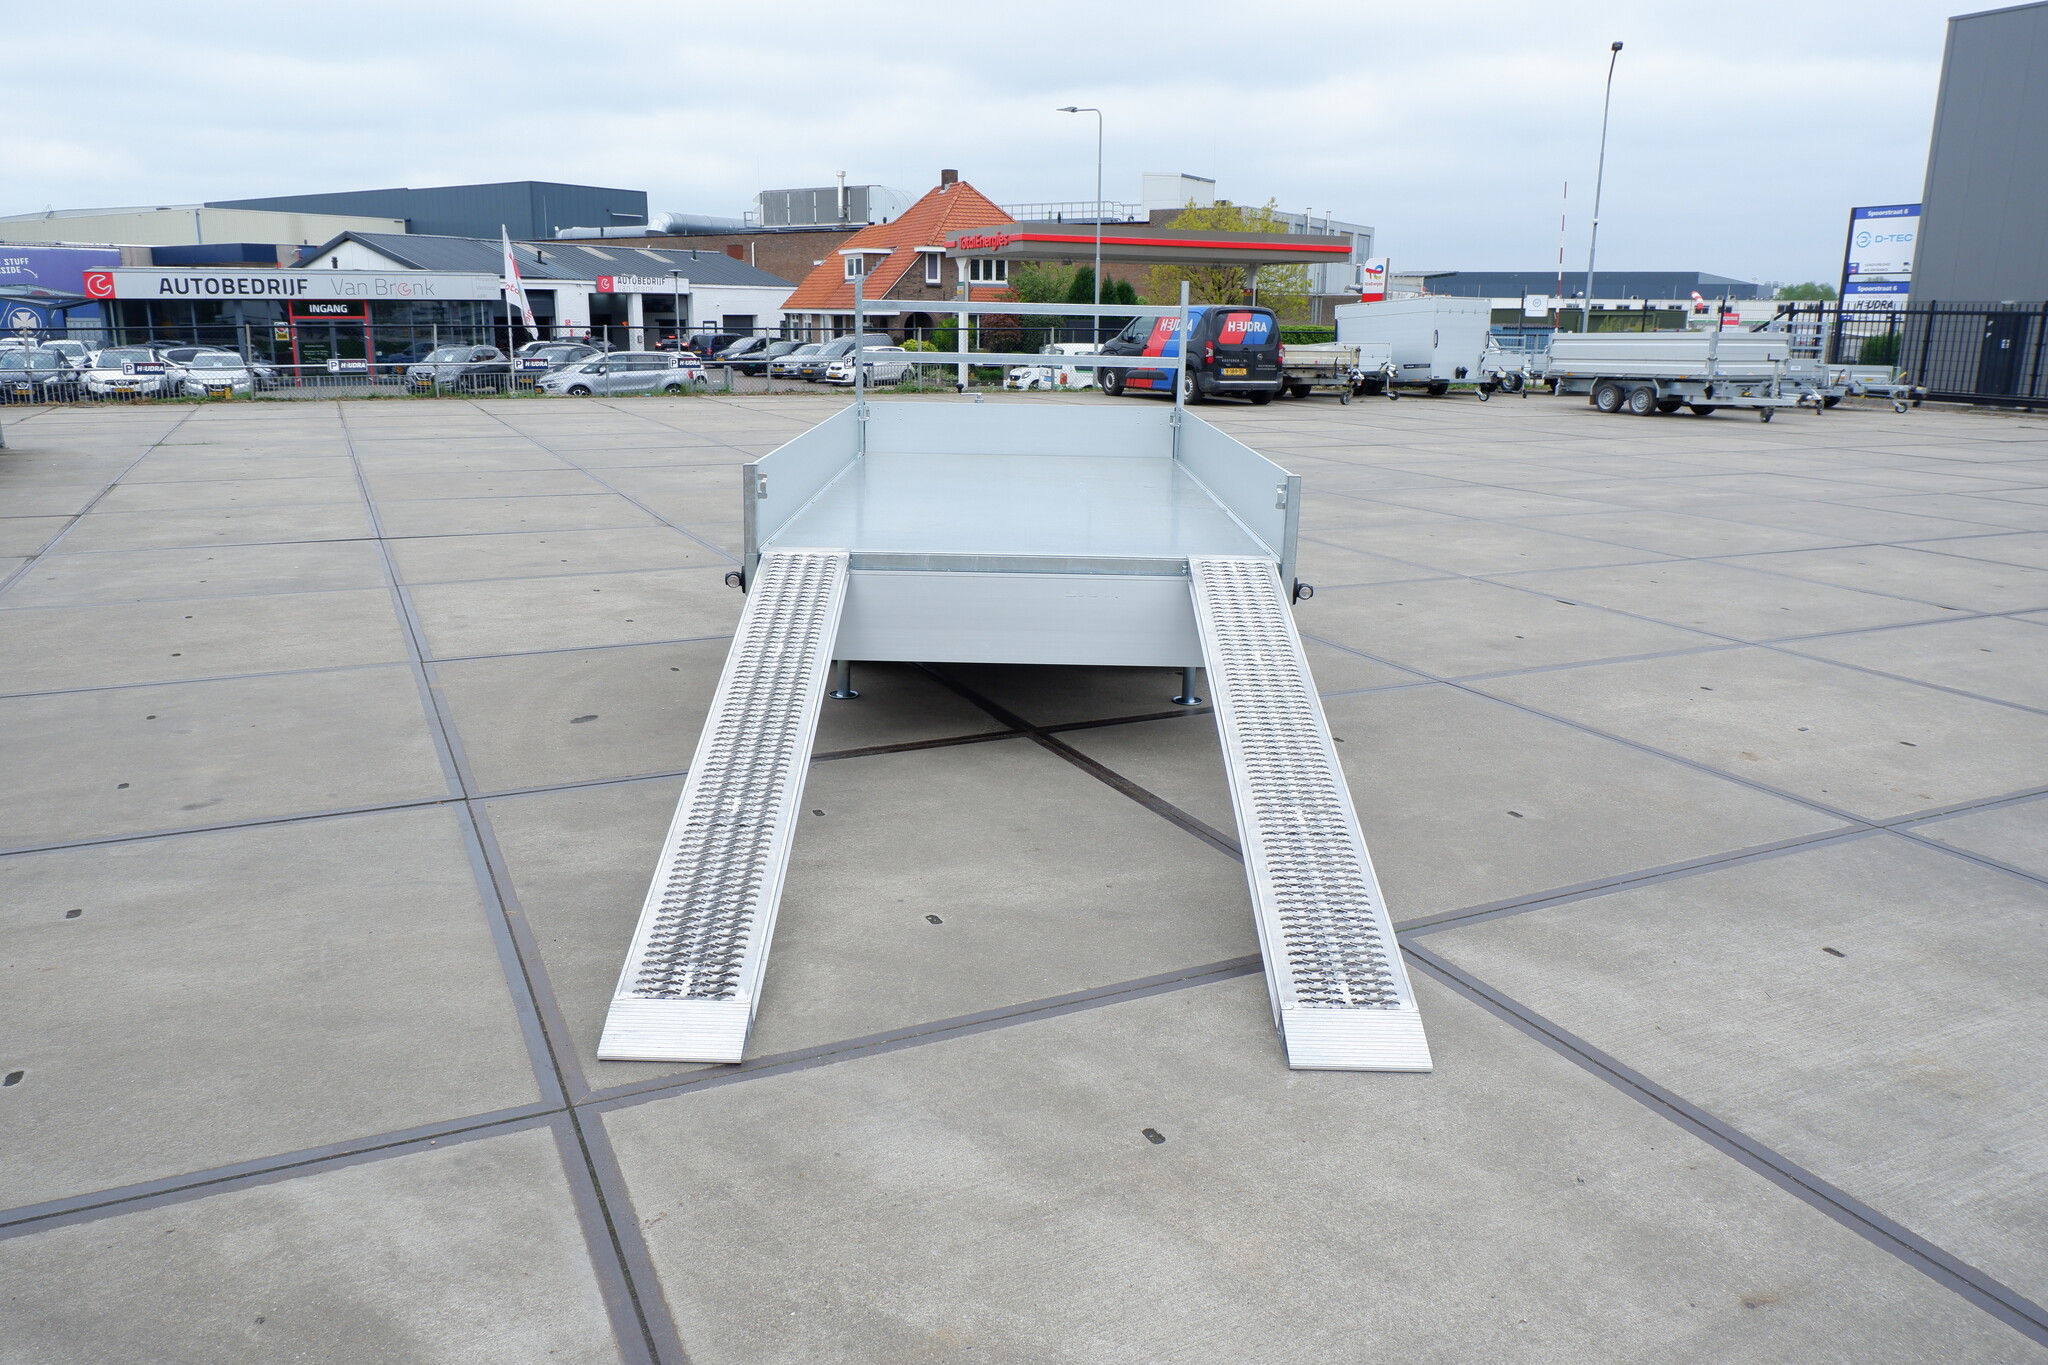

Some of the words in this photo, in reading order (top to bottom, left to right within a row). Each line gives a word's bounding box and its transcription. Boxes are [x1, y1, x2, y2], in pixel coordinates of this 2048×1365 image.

[1867, 209, 1903, 217] Spoorstraat
[958, 231, 1009, 251] TotalEnergies
[1874, 233, 1913, 243] D-TEC
[4, 257, 29, 266] STUFF
[0, 266, 22, 274] SIDE
[617, 276, 666, 286] AUTOBEDRIJF
[159, 277, 308, 296] AUTOBEDRIJF
[330, 278, 369, 296] Van
[309, 304, 348, 313] INGANG
[1160, 318, 1193, 332] HEUDA
[1227, 321, 1268, 333] HEUDRA
[330, 361, 338, 370] P
[515, 359, 523, 368] P
[125, 364, 133, 373] P
